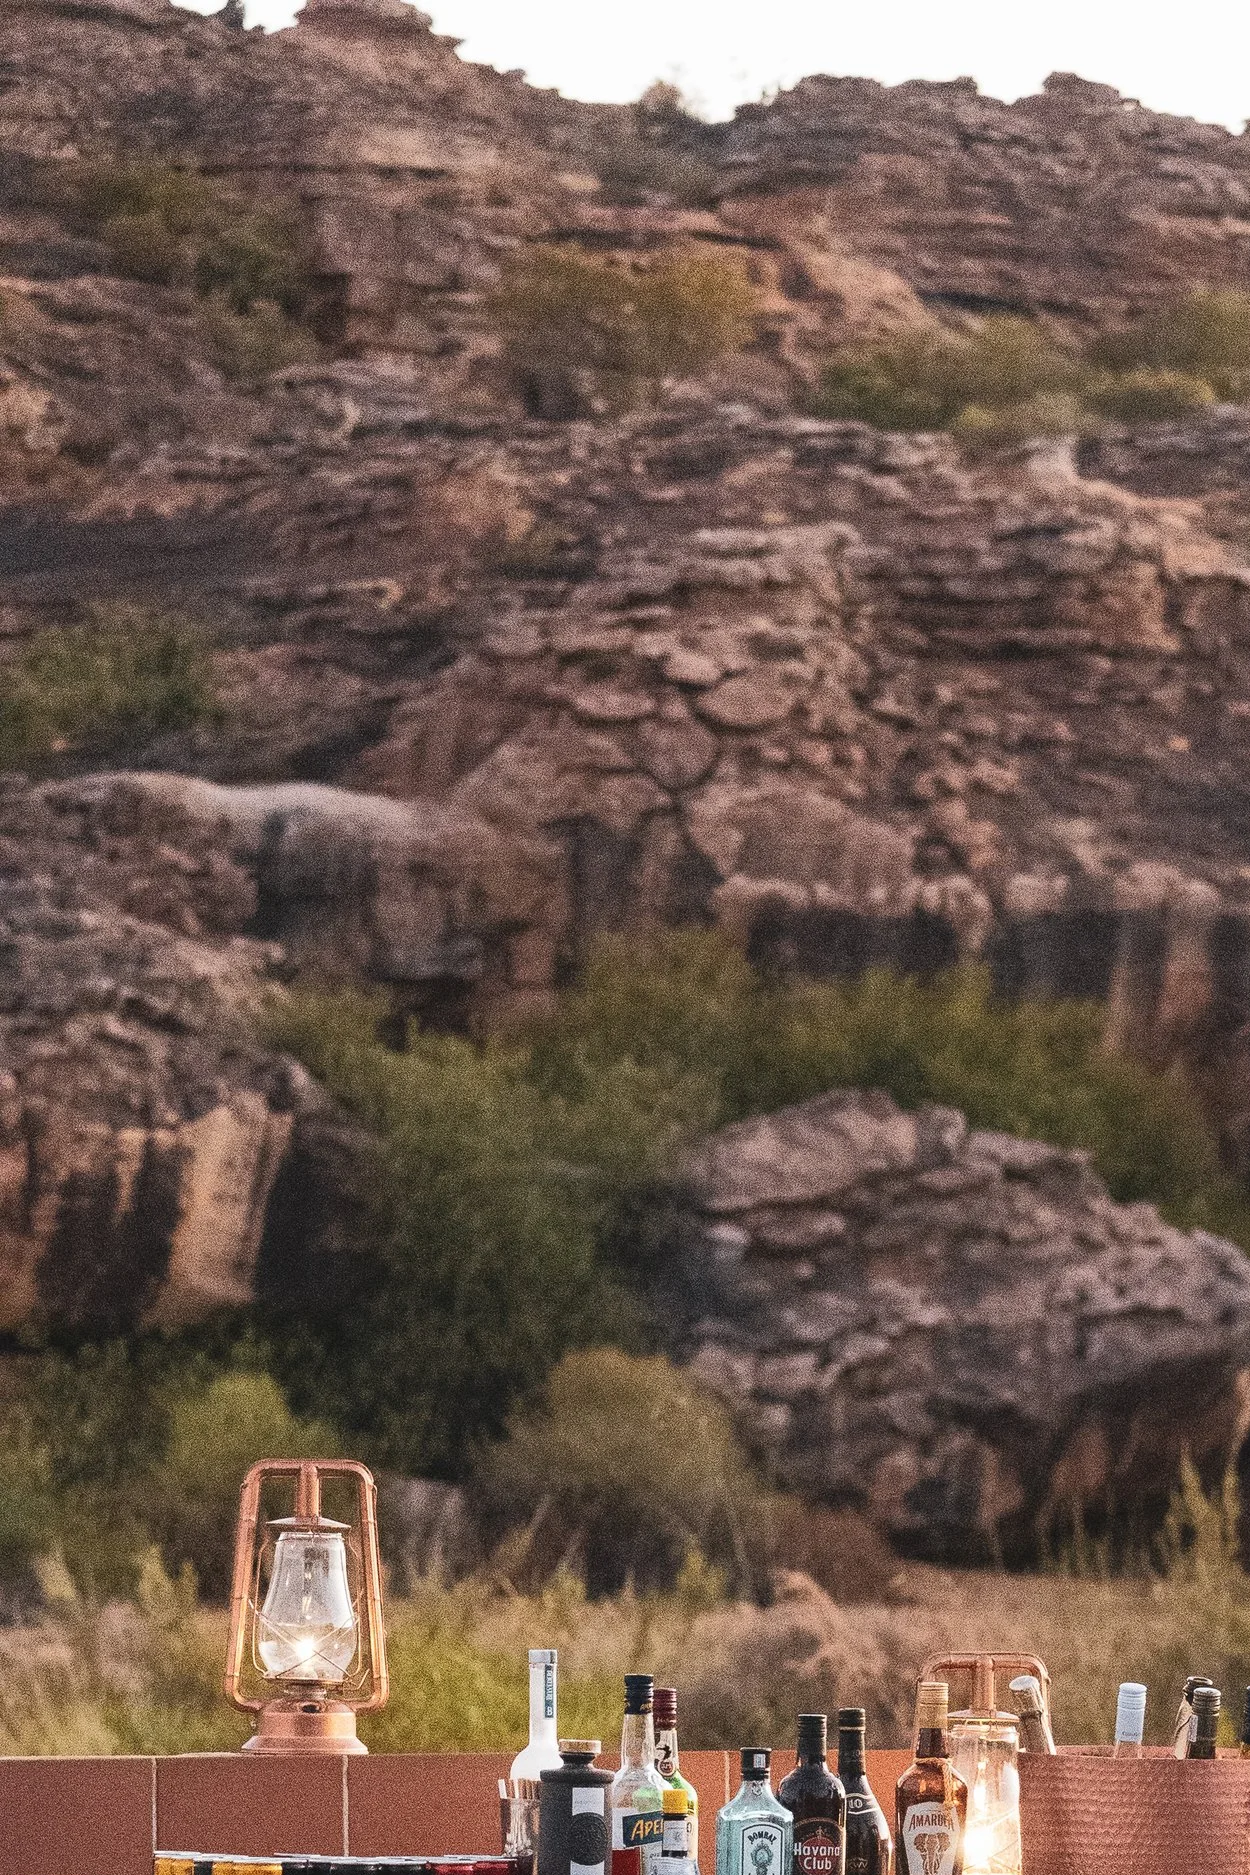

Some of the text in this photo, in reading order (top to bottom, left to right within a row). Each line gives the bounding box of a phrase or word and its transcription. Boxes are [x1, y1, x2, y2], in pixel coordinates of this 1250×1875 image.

[848, 1799, 863, 1809] 10
[630, 1818, 663, 1841] APE
[747, 1831, 778, 1845] BOMBAY
[793, 1842, 840, 1856] Havana
[803, 1857, 832, 1870] Club
